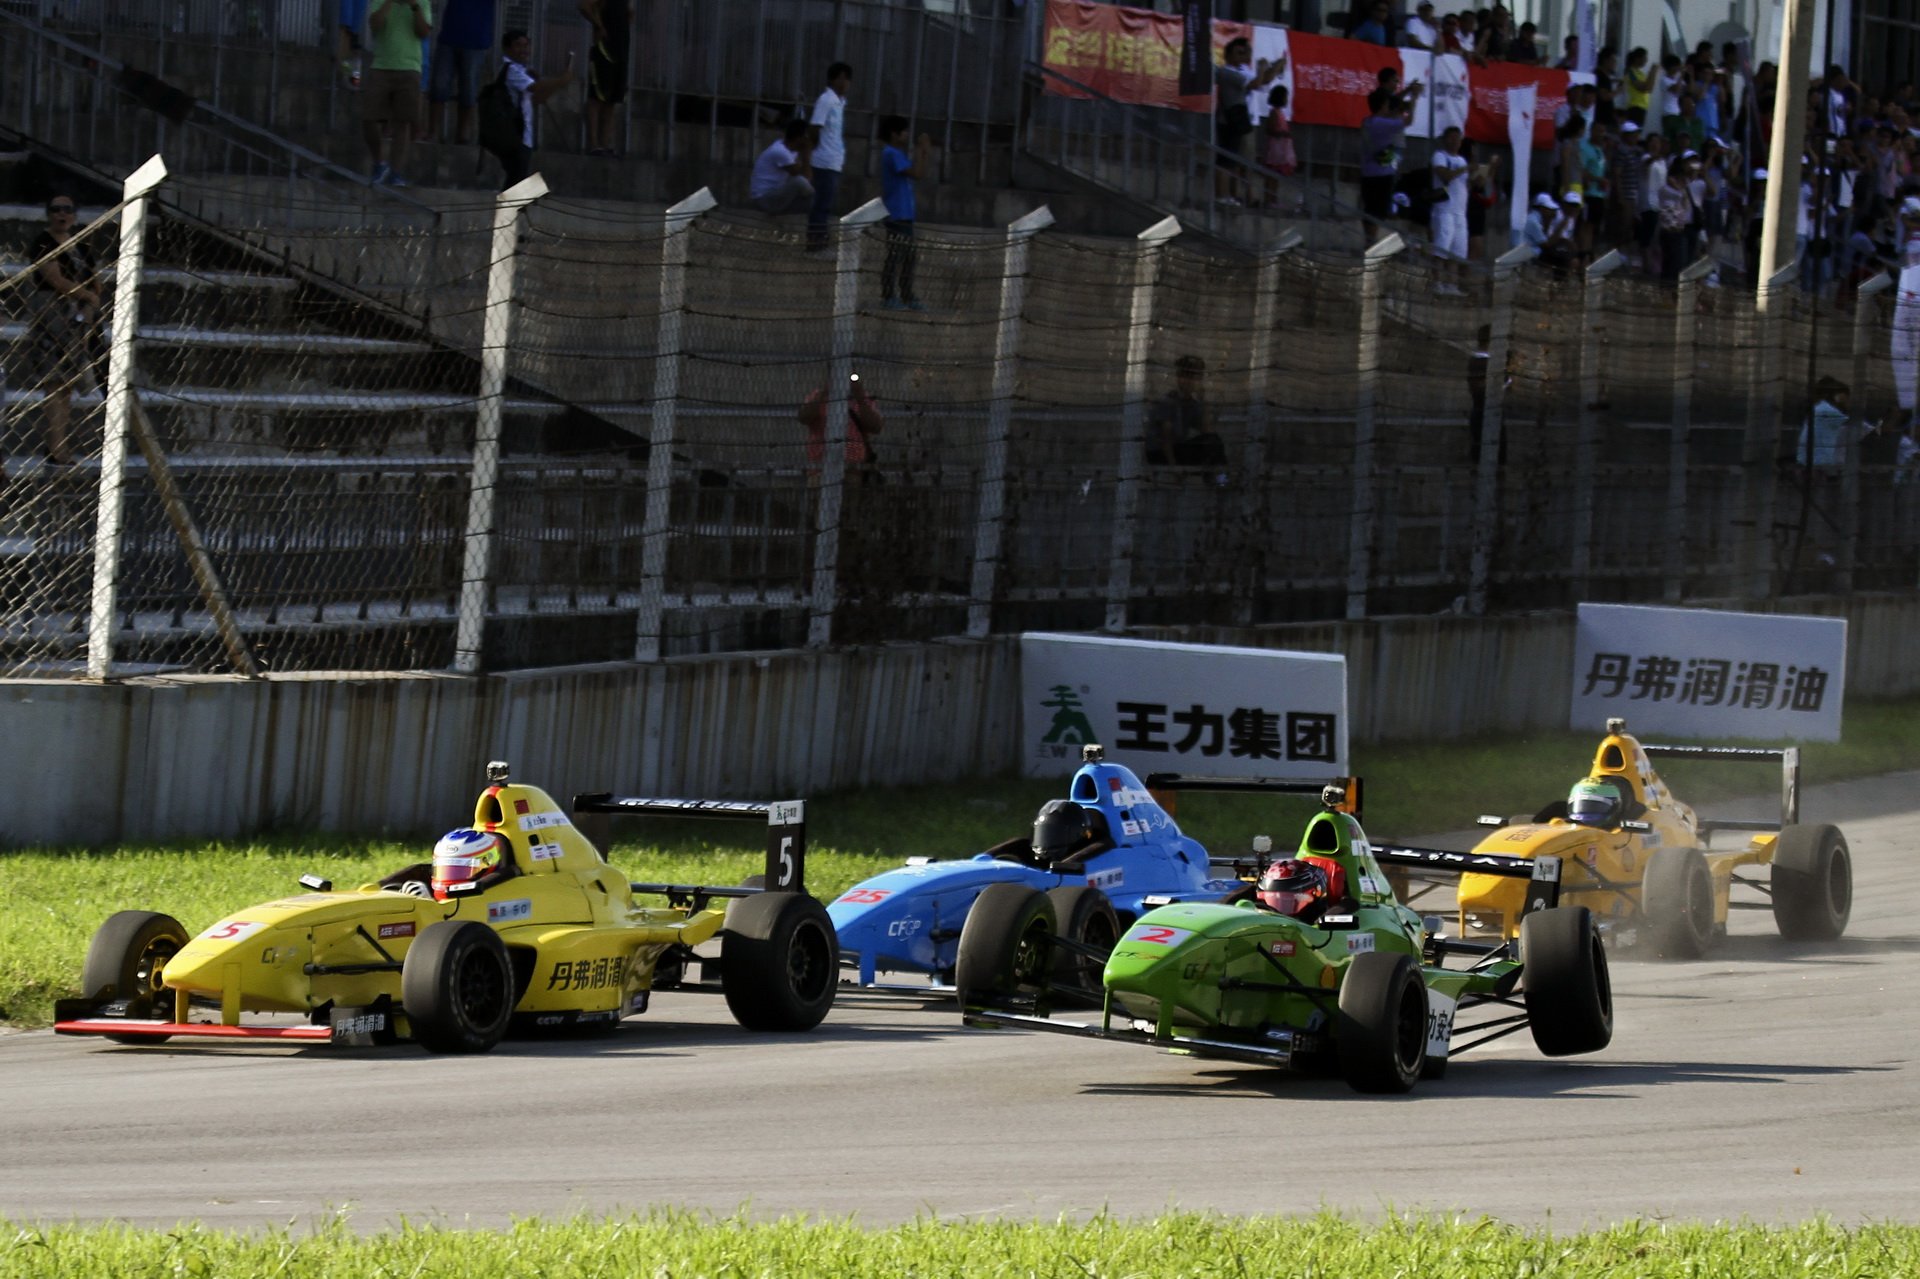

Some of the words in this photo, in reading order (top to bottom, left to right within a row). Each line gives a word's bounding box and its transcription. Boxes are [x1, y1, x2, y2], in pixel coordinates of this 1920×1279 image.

[1582, 653, 1828, 712] 丹弗润滑油
[1116, 702, 1337, 764] 王力集团
[778, 837, 793, 886] 5
[836, 889, 893, 904] 25
[208, 921, 251, 939] 5
[1137, 927, 1176, 944] 2
[547, 956, 627, 991] 丹弗润滑
